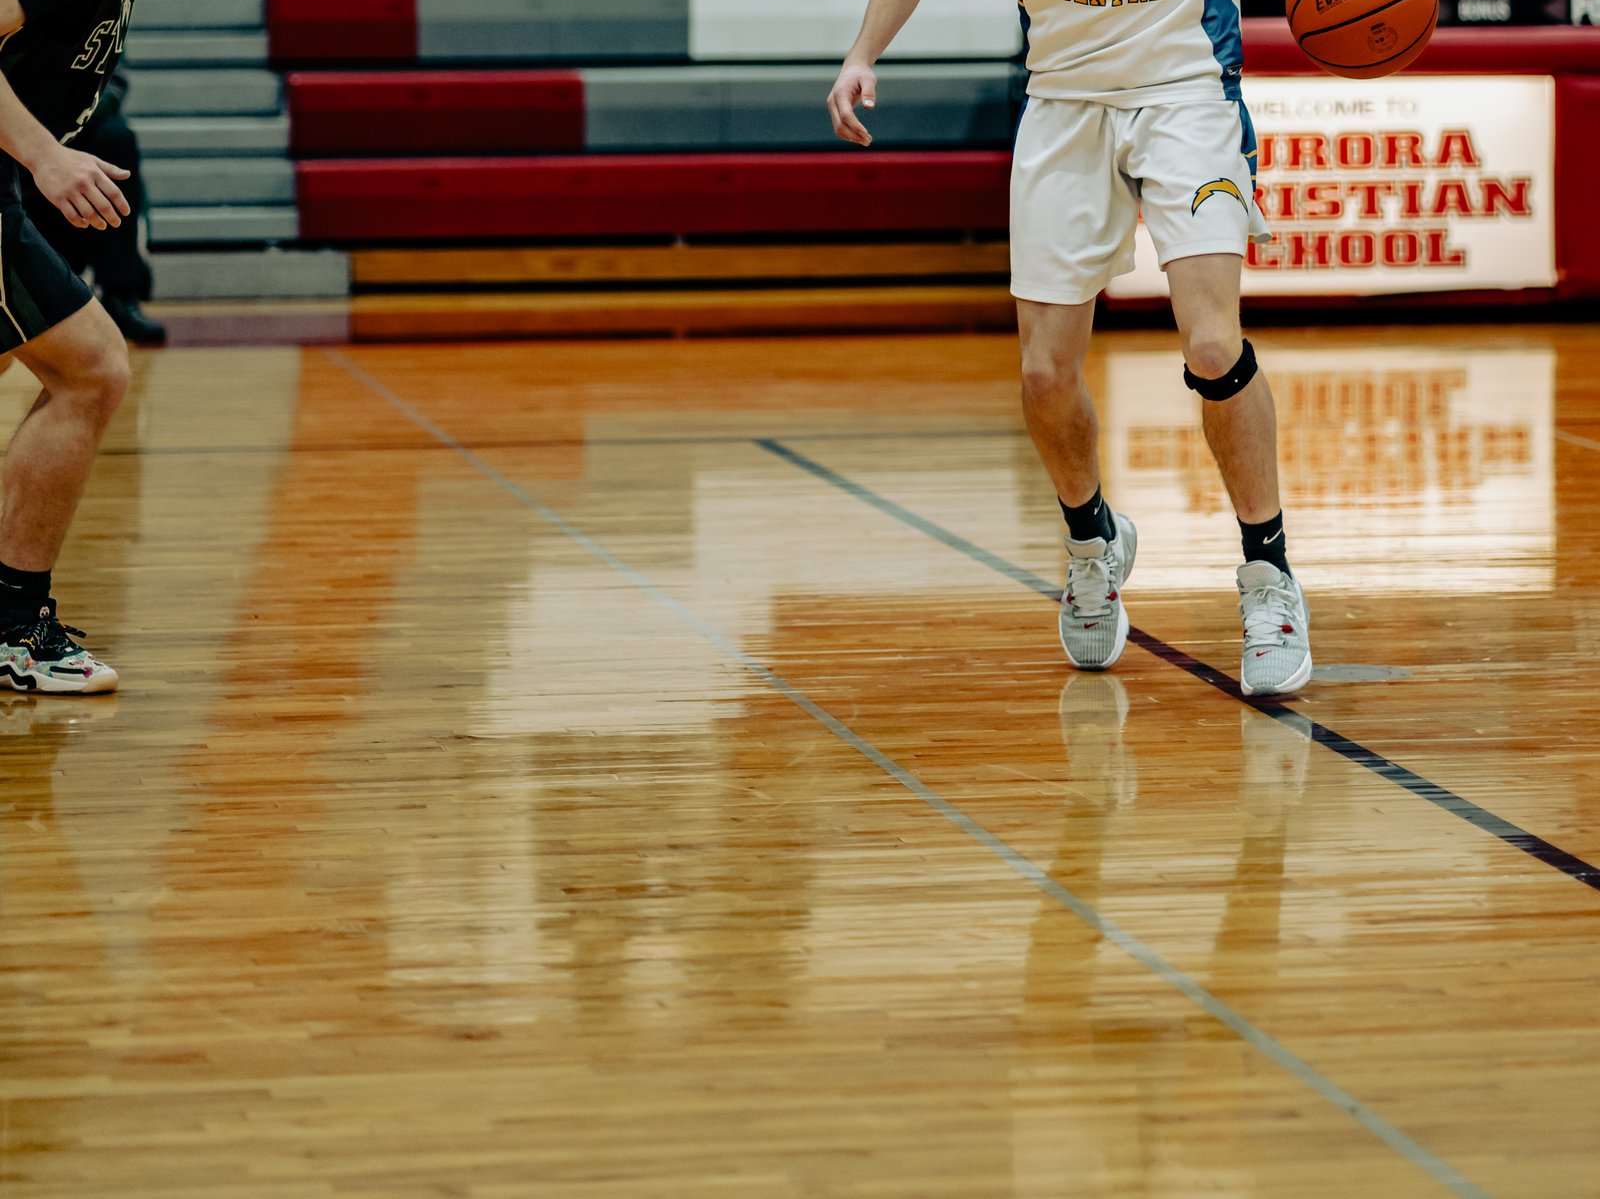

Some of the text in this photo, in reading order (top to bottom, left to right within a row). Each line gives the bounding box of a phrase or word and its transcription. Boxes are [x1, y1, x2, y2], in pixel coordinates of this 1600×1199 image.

[1387, 99, 1417, 115] TO
[1257, 130, 1481, 170] URORA
[1253, 177, 1532, 220] ISTIAN
[1246, 228, 1467, 269] CHOOL
